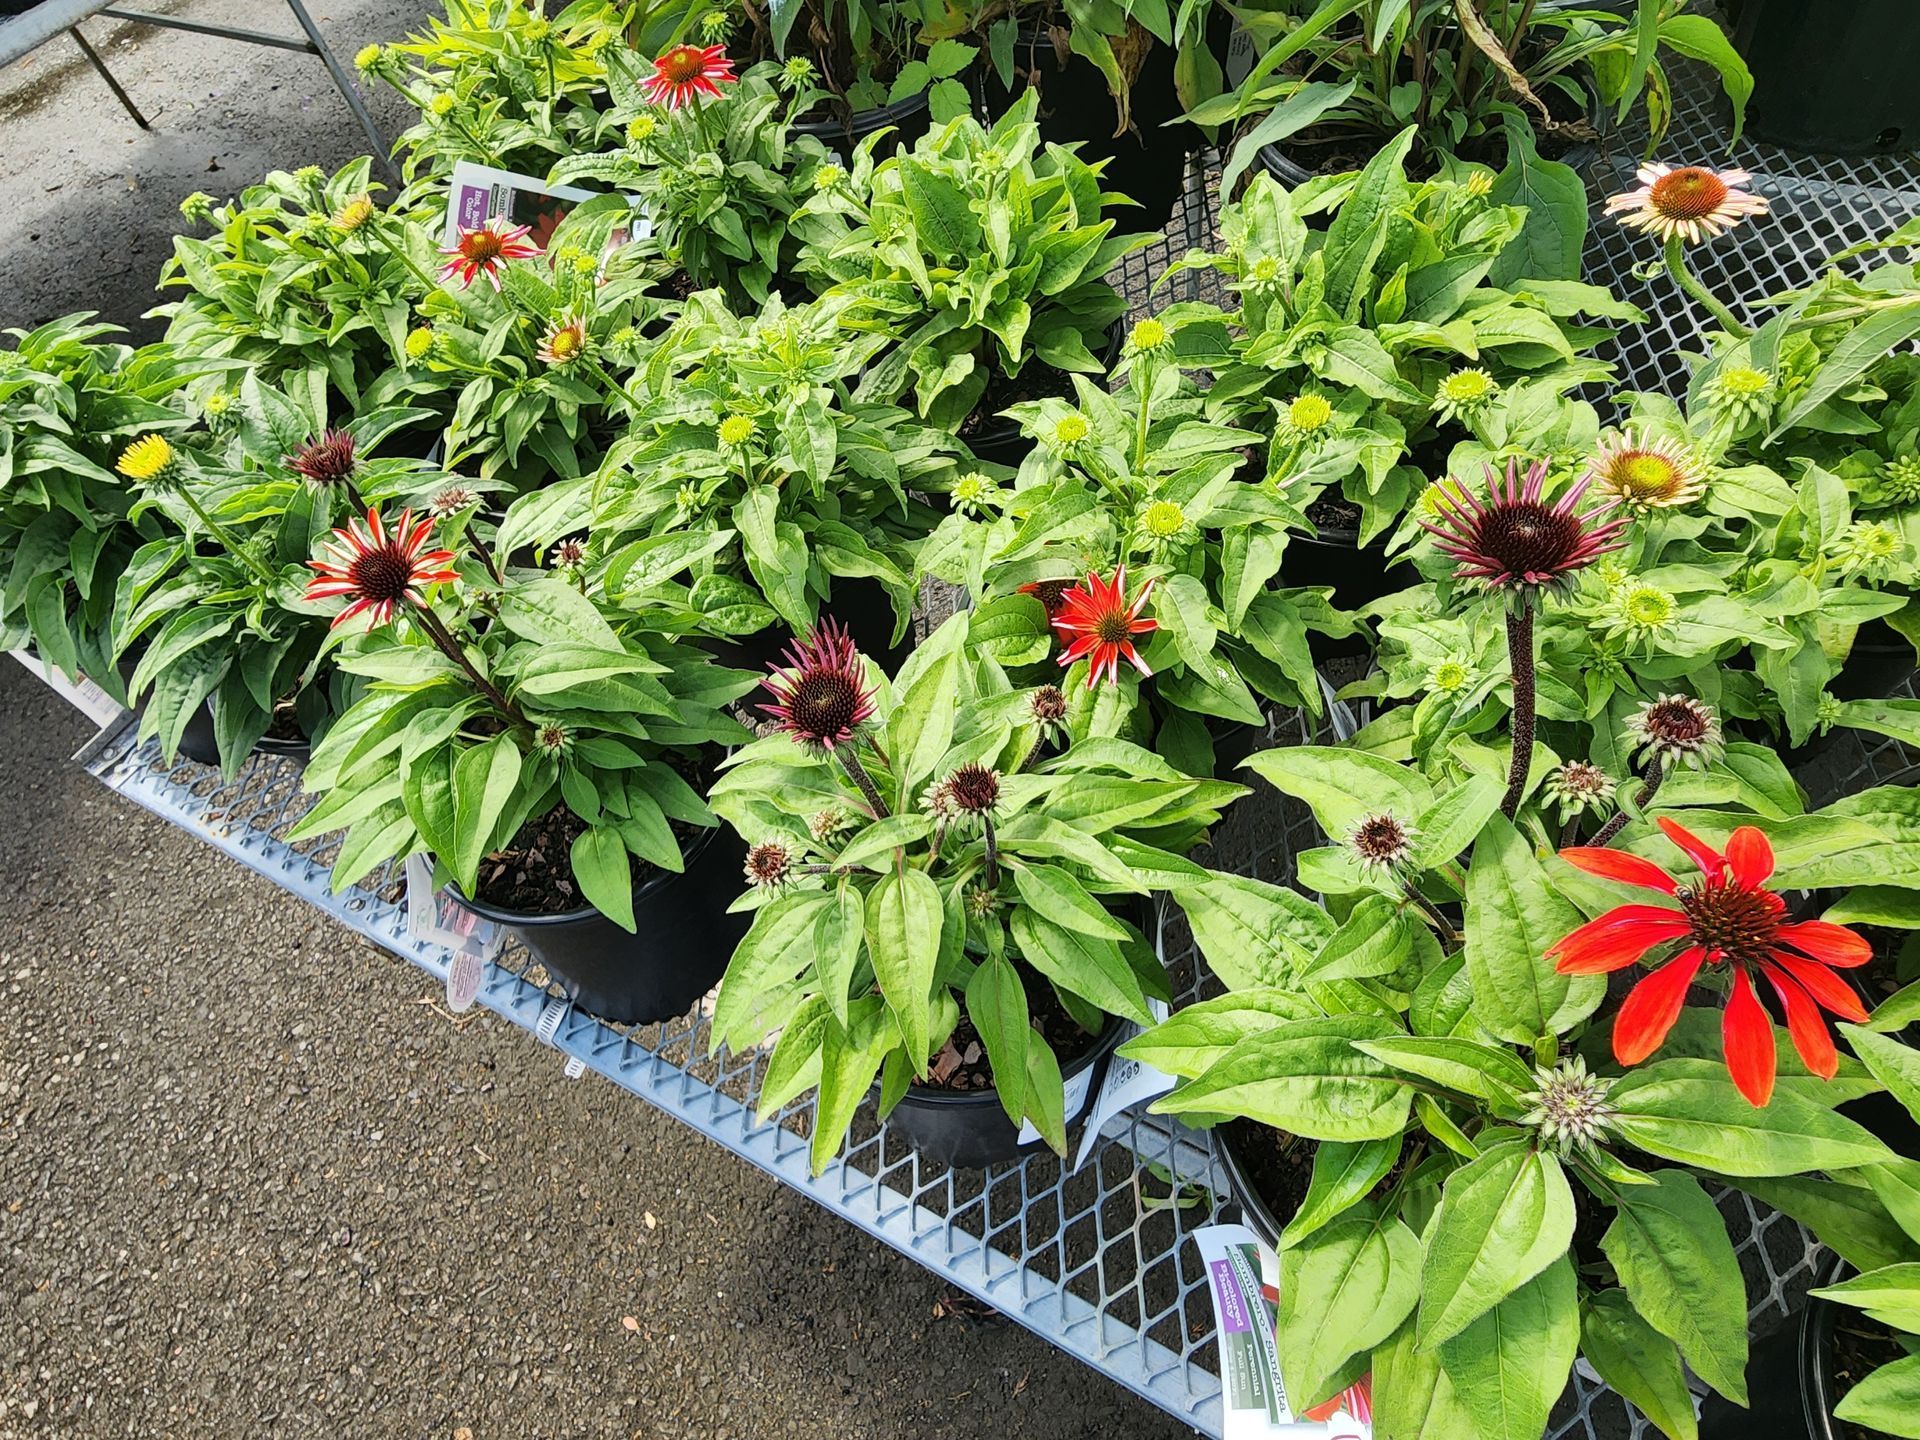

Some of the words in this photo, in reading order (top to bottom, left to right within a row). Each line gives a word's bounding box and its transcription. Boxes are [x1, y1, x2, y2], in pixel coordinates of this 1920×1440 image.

[465, 197, 473, 220] Color
[471, 210, 480, 229] Bold
[1218, 1272, 1235, 1320] Beauty
[1219, 1263, 1244, 1328] Bi-colored
[1237, 1350, 1245, 1369] Full
[1247, 1343, 1261, 1397] Perennial
[1265, 1340, 1286, 1414] Sangrita
